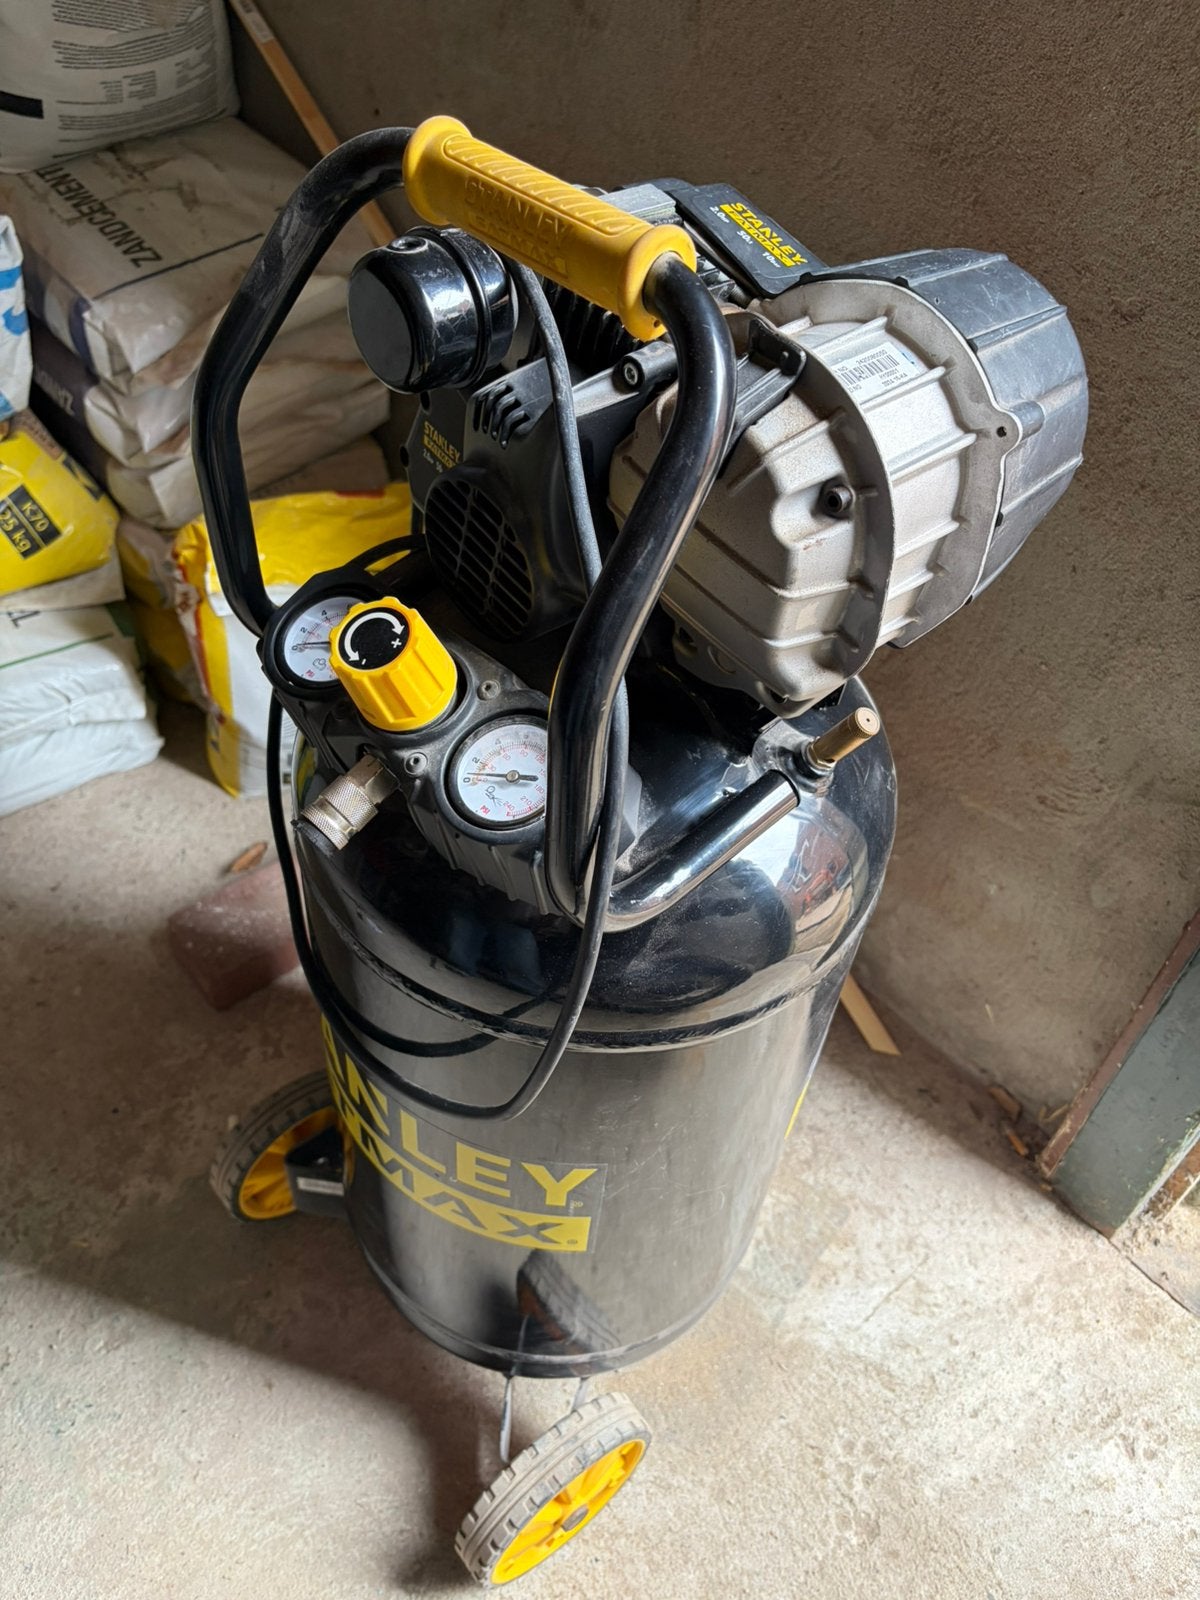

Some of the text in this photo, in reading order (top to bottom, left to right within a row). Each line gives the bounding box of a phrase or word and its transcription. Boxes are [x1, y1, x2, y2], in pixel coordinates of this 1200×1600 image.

[34, 165, 162, 268] ZANDCEMENT
[731, 202, 808, 264] STANLEY
[21, 500, 50, 533] K70
[12, 529, 32, 553] kg
[300, 626, 308, 634] 2
[472, 756, 480, 764] 2
[520, 795, 532, 806] 210
